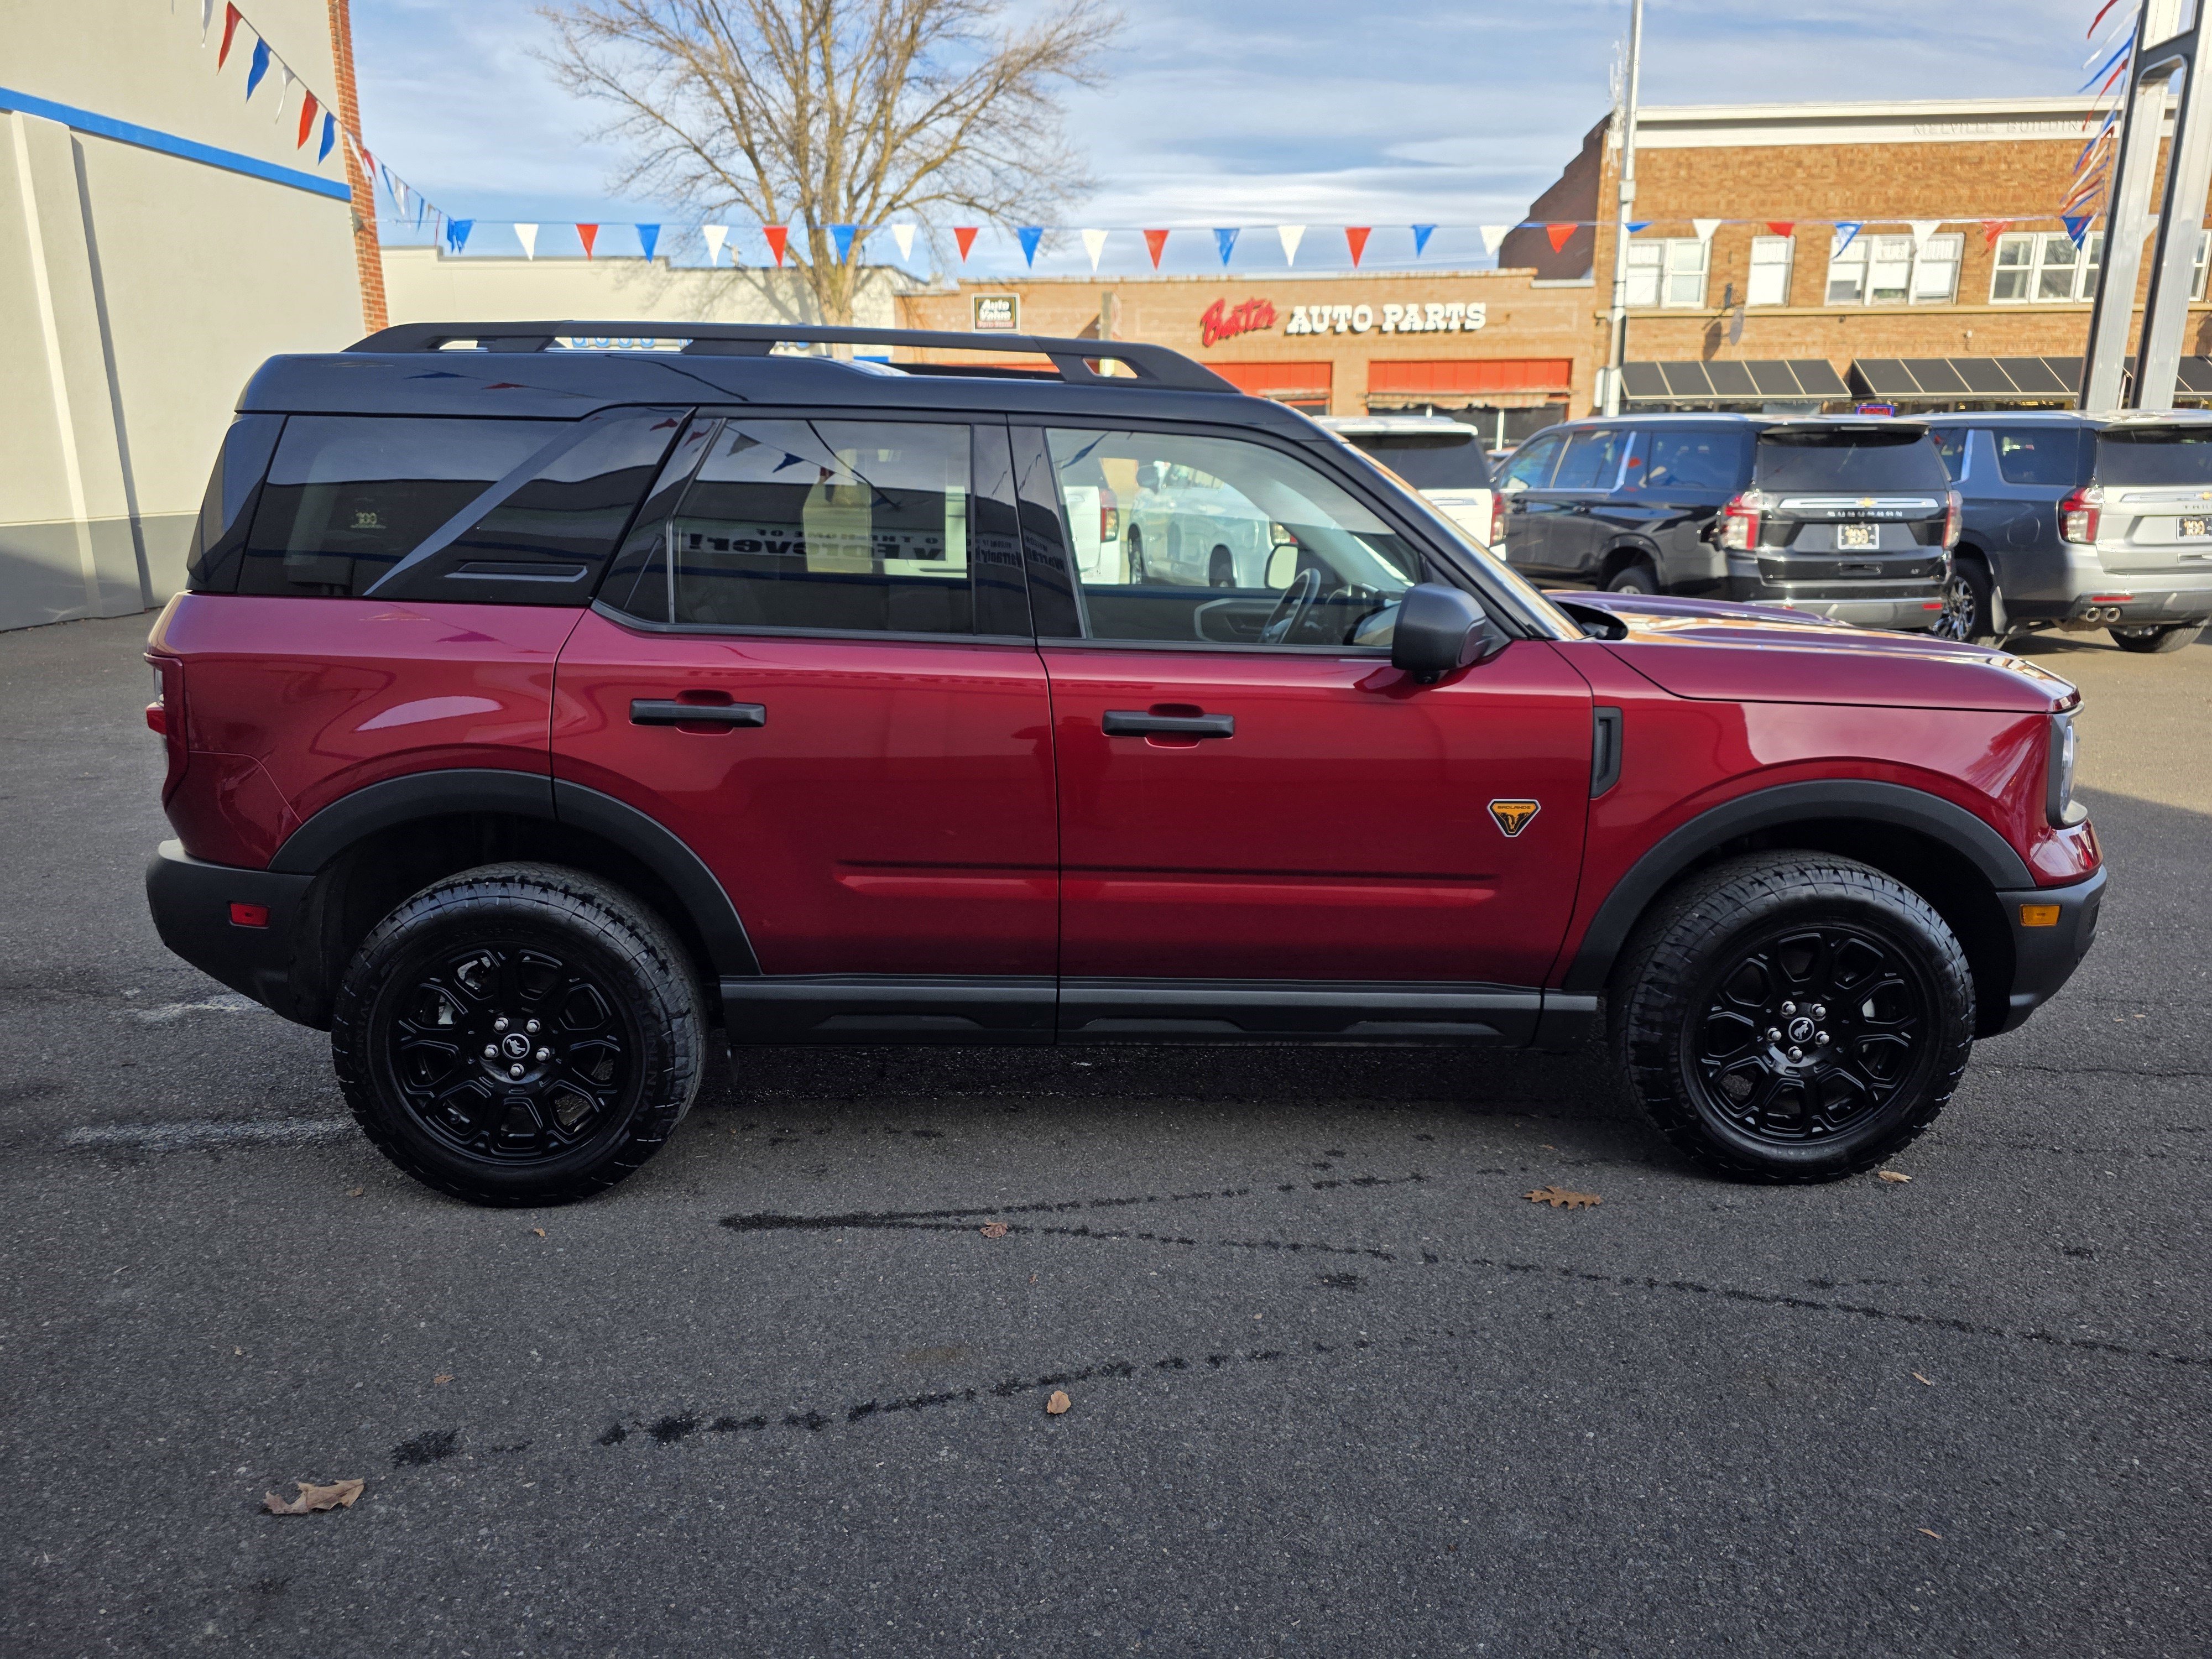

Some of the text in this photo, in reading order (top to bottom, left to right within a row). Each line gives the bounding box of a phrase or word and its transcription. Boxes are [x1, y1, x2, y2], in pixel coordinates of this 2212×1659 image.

[979, 299, 1010, 311] Auto
[1199, 296, 1486, 347] Baxter AUTO PARTS
[2183, 520, 2205, 536] 100
[1845, 529, 1869, 545] 100
